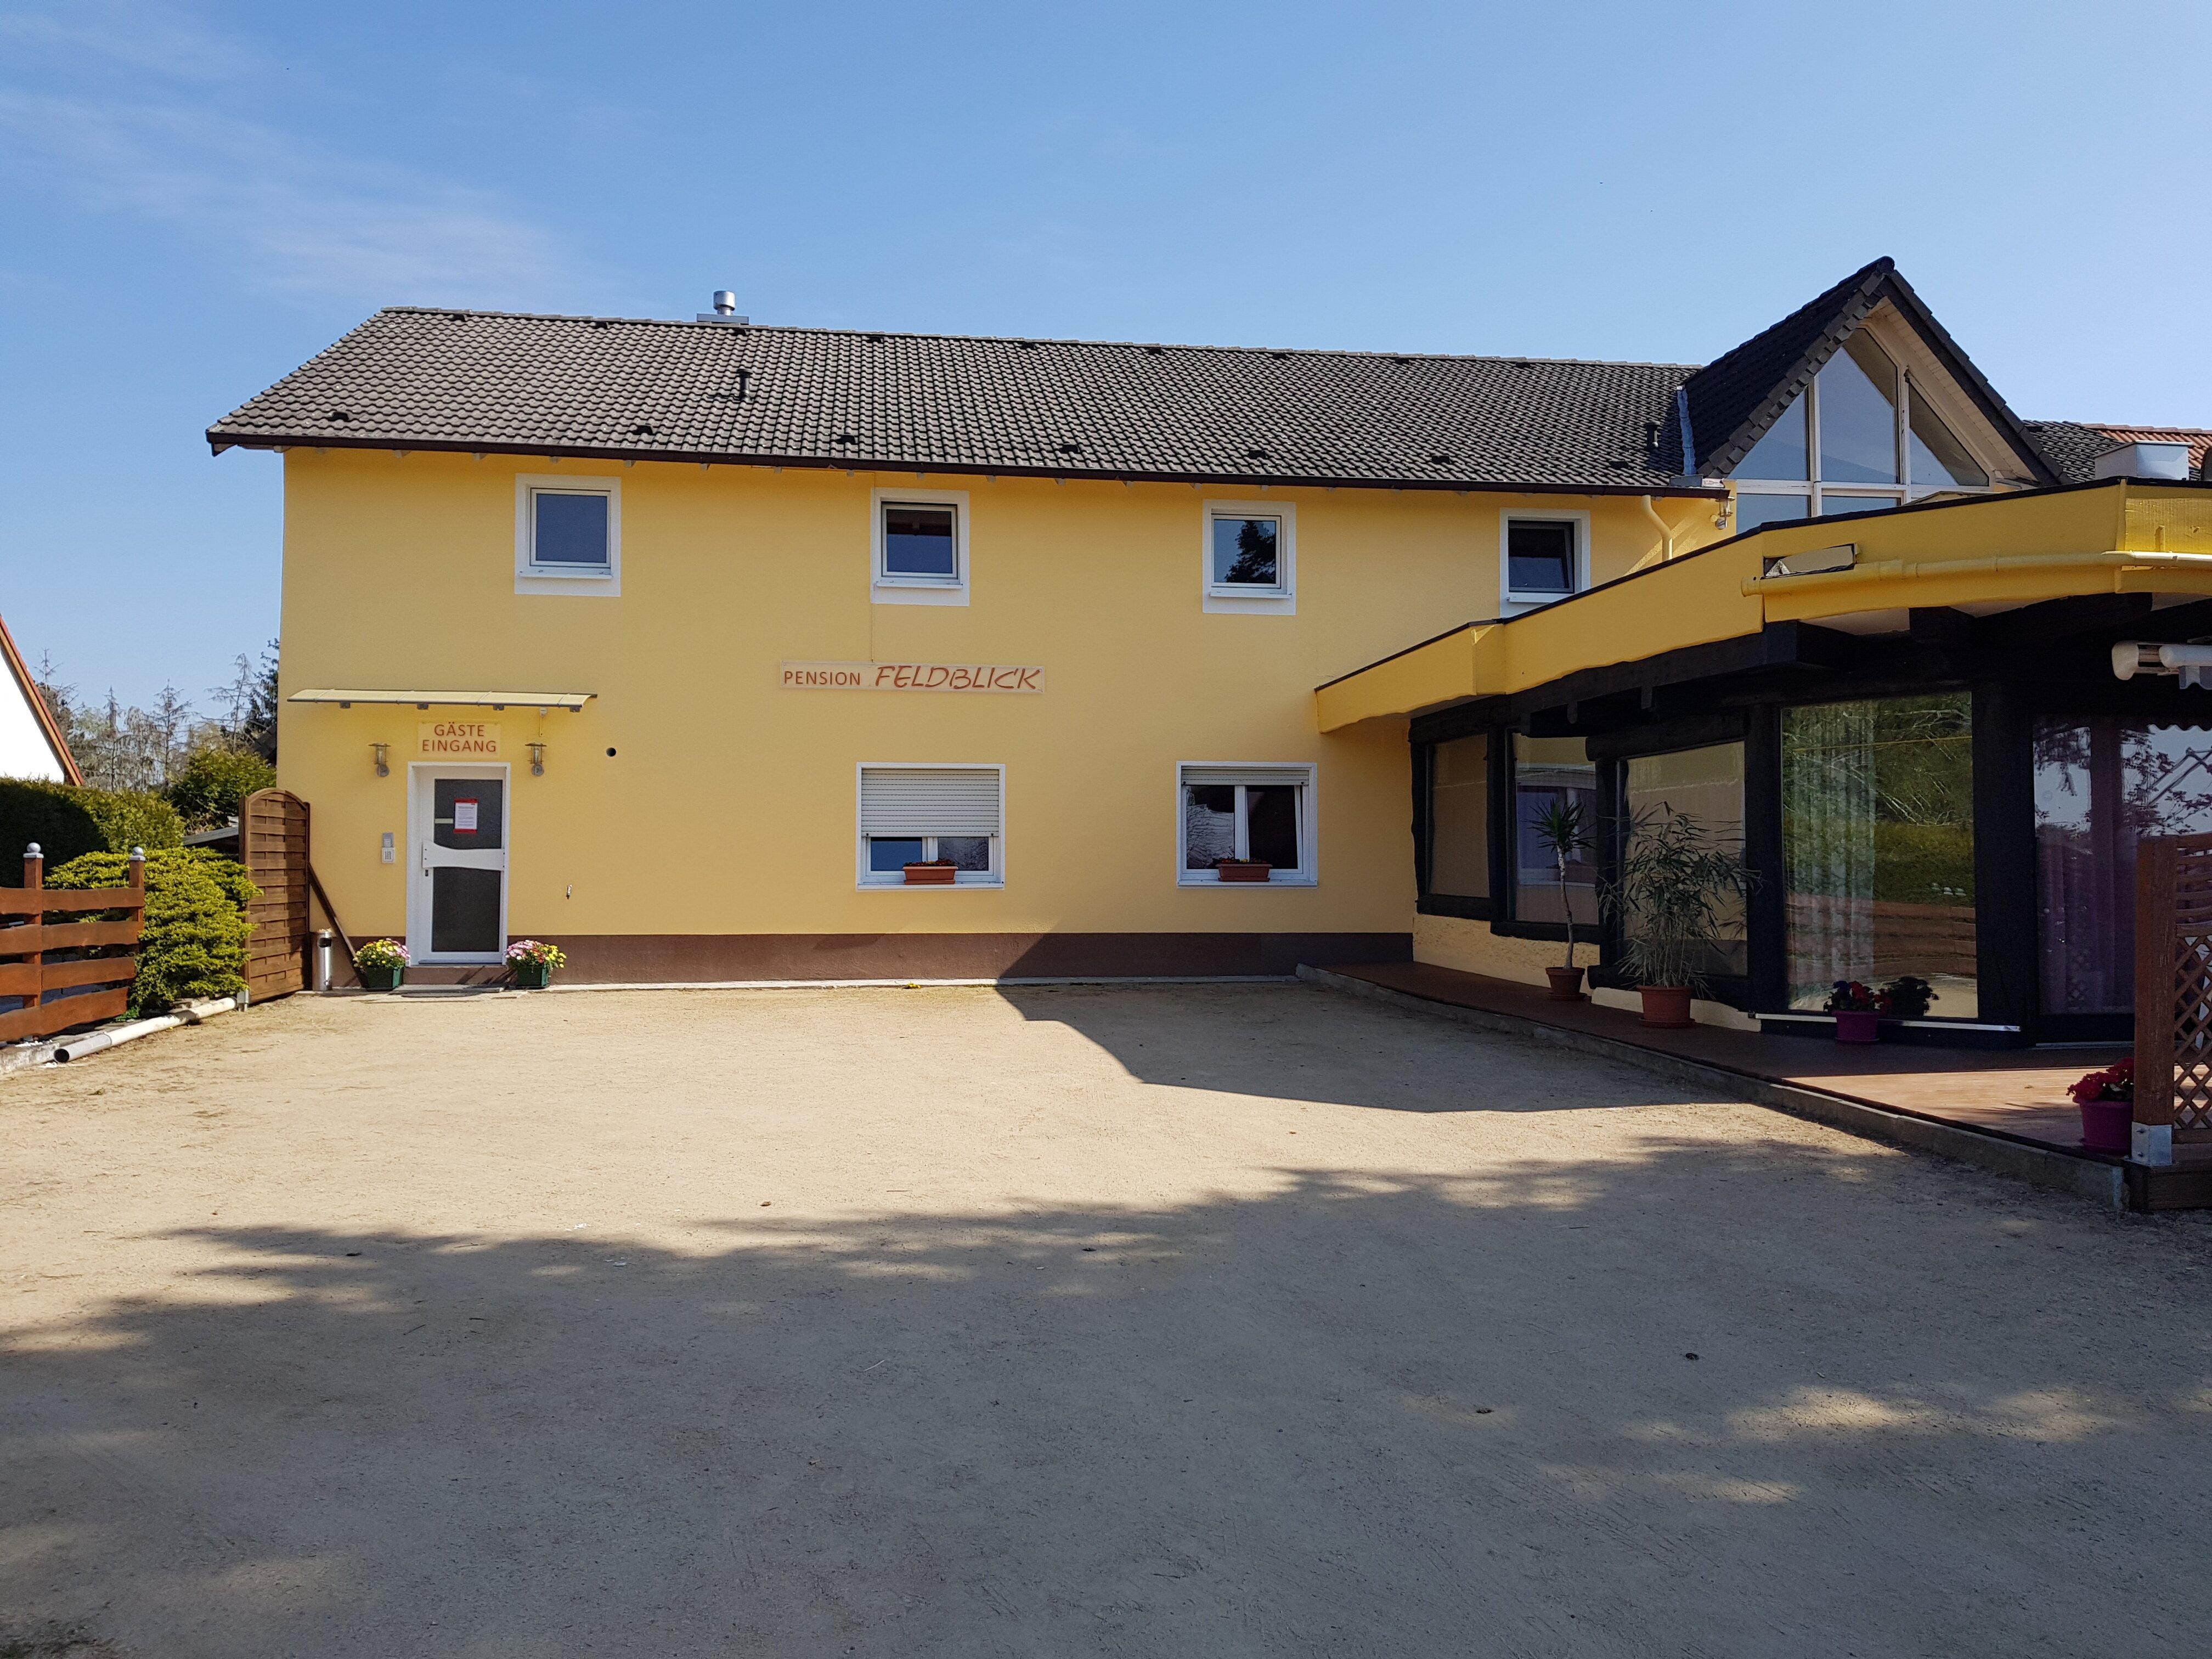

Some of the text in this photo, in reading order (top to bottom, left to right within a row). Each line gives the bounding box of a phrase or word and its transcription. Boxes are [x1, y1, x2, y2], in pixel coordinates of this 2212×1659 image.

[783, 665, 1040, 690] PENSION FELDBLICK
[434, 721, 485, 737] GÄSTE
[422, 739, 496, 752] EINGANG
